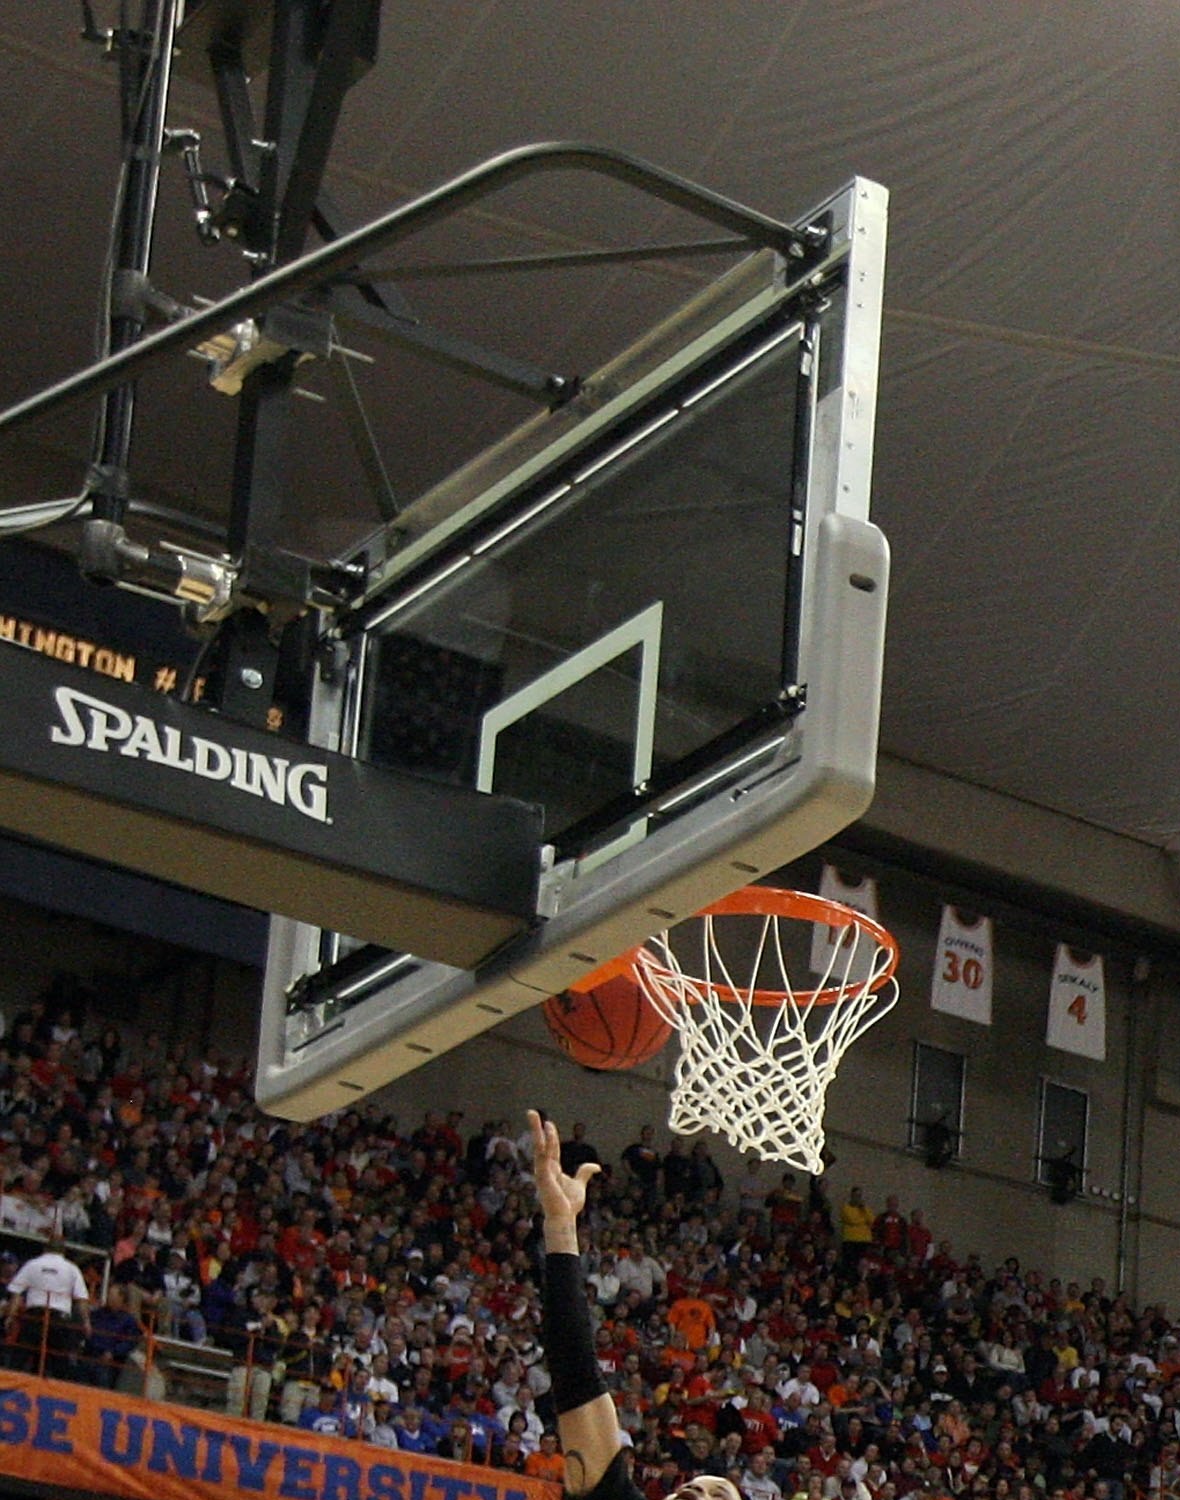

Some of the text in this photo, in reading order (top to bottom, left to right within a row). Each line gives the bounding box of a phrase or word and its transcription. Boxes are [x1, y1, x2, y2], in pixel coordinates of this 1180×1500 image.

[51, 686, 329, 823] SPALDING
[943, 950, 984, 990] 30
[1066, 994, 1088, 1026] 4
